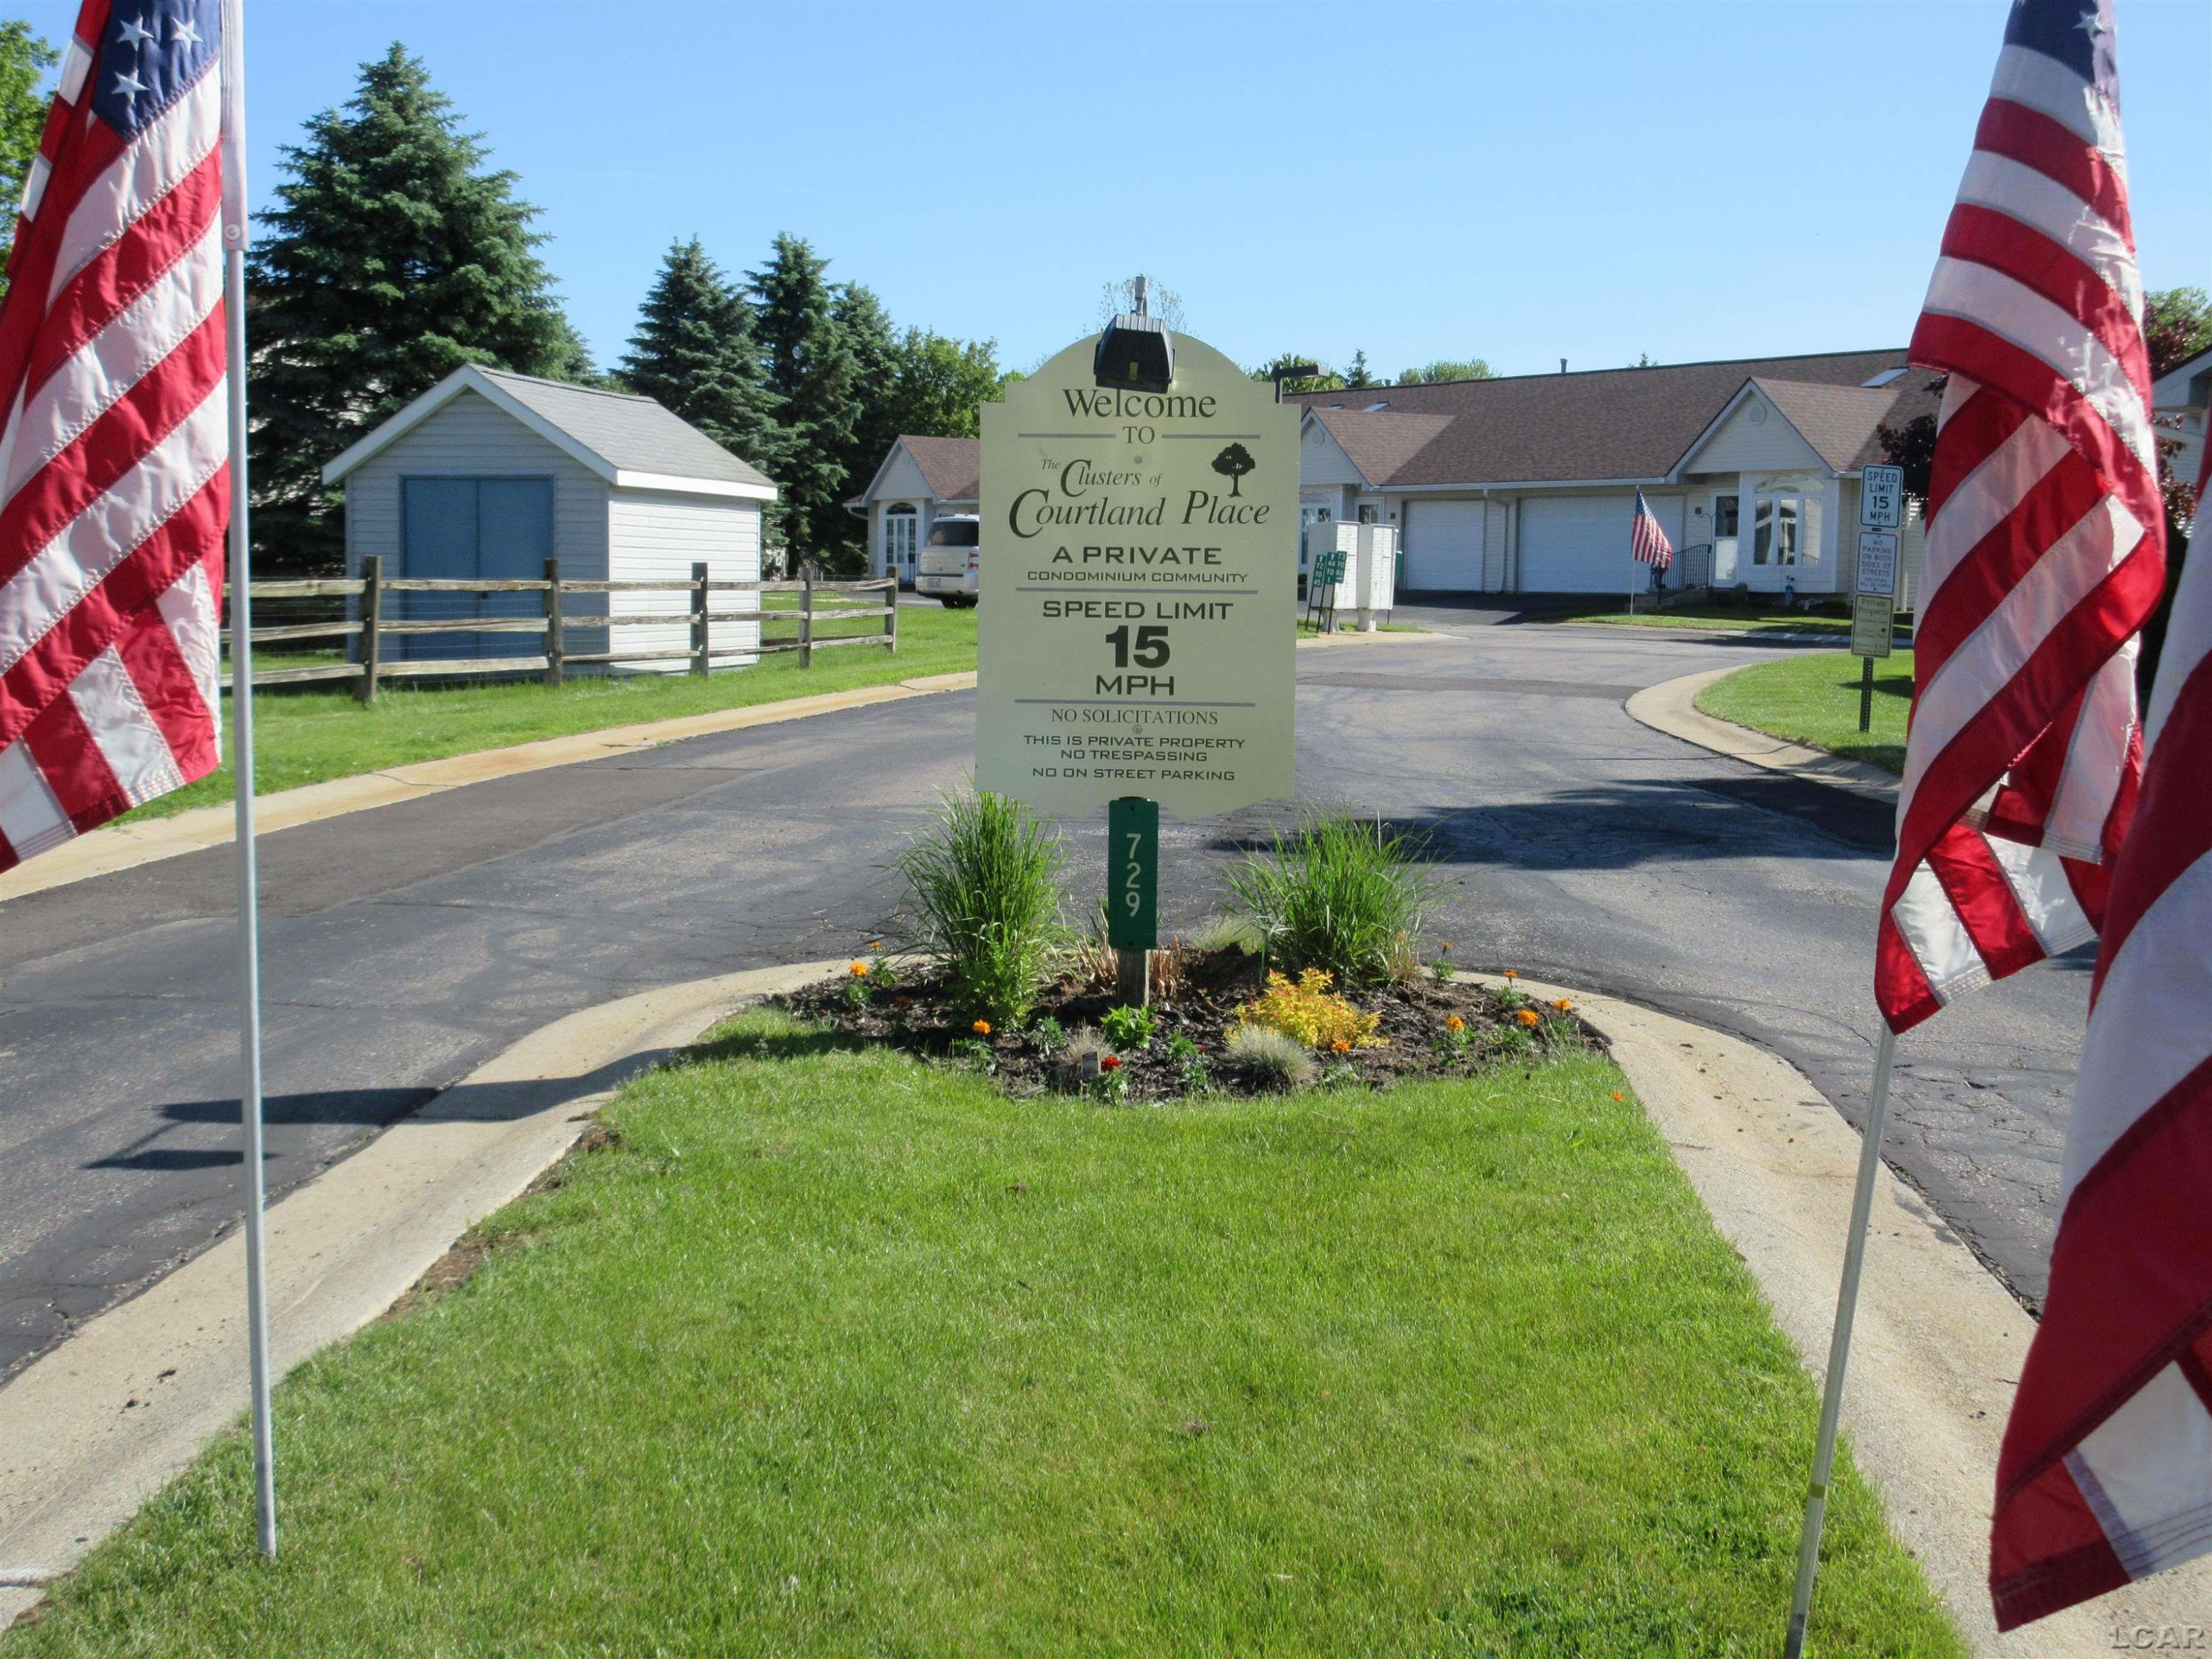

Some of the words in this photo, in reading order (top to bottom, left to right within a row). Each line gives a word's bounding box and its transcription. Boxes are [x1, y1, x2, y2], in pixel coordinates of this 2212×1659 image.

[1062, 389, 1217, 418] Welcome
[1122, 425, 1155, 445] TO
[1041, 459, 1060, 470] The
[1060, 459, 1141, 498] Clusters
[1150, 472, 1164, 487] of
[1867, 472, 1897, 482] SPEED
[1869, 484, 1893, 494] LIMIT
[1873, 496, 1888, 509] 15
[1009, 489, 1166, 538] Courtland
[1181, 490, 1270, 525] Place
[1870, 512, 1890, 521] MPH
[1052, 546, 1073, 563] A
[1082, 546, 1222, 565] PRIVATE
[1027, 571, 1147, 582] CONDOMINIUM
[1152, 572, 1248, 583] COMMUNITY
[1863, 568, 1891, 577] STREETS
[1043, 600, 1146, 619] SPEED
[1157, 602, 1234, 619] LIMIT
[1105, 625, 1170, 669] 15
[1096, 675, 1175, 695] MPH
[1051, 709, 1077, 723] NO
[1082, 709, 1218, 725] SOLICITATIONS
[1024, 735, 1061, 746] THIS
[1067, 736, 1082, 745] IS
[1088, 736, 1154, 748] PRIVATE
[1159, 737, 1246, 748] PROPERTY
[1061, 750, 1085, 759] NO
[1091, 750, 1207, 762] TRESPASSING
[1033, 768, 1057, 778] NO
[1063, 768, 1088, 779] ON
[1093, 768, 1156, 779] STREET
[1161, 769, 1235, 781] PARKING
[1126, 833, 1141, 917] 729
